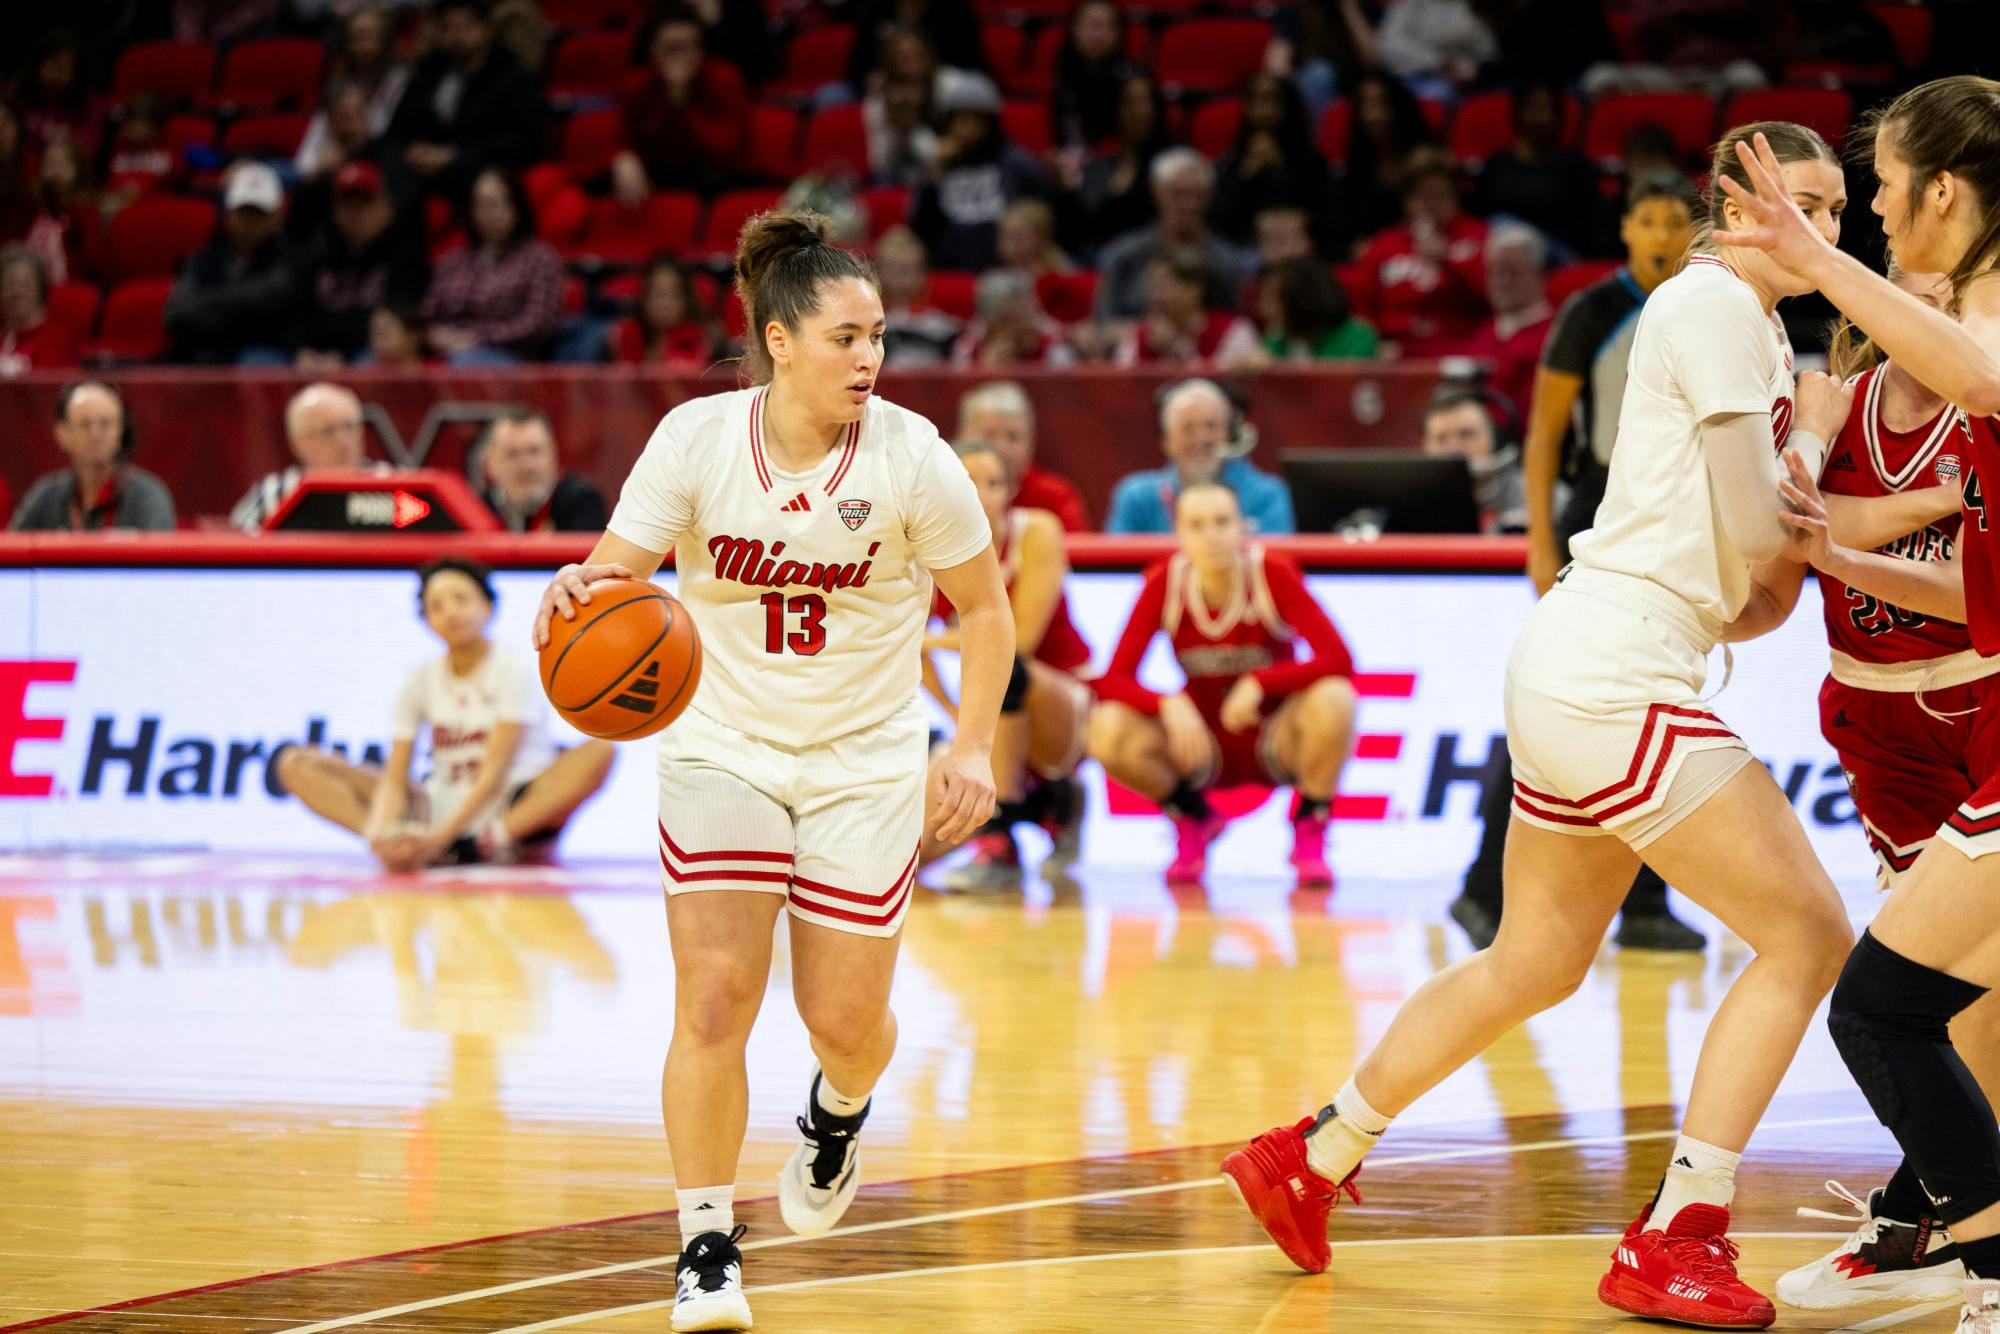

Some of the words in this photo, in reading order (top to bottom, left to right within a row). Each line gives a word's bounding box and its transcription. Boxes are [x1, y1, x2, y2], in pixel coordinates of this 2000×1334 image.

[840, 508, 869, 518] MAC
[708, 534, 882, 594] Miami
[760, 591, 827, 656] 13
